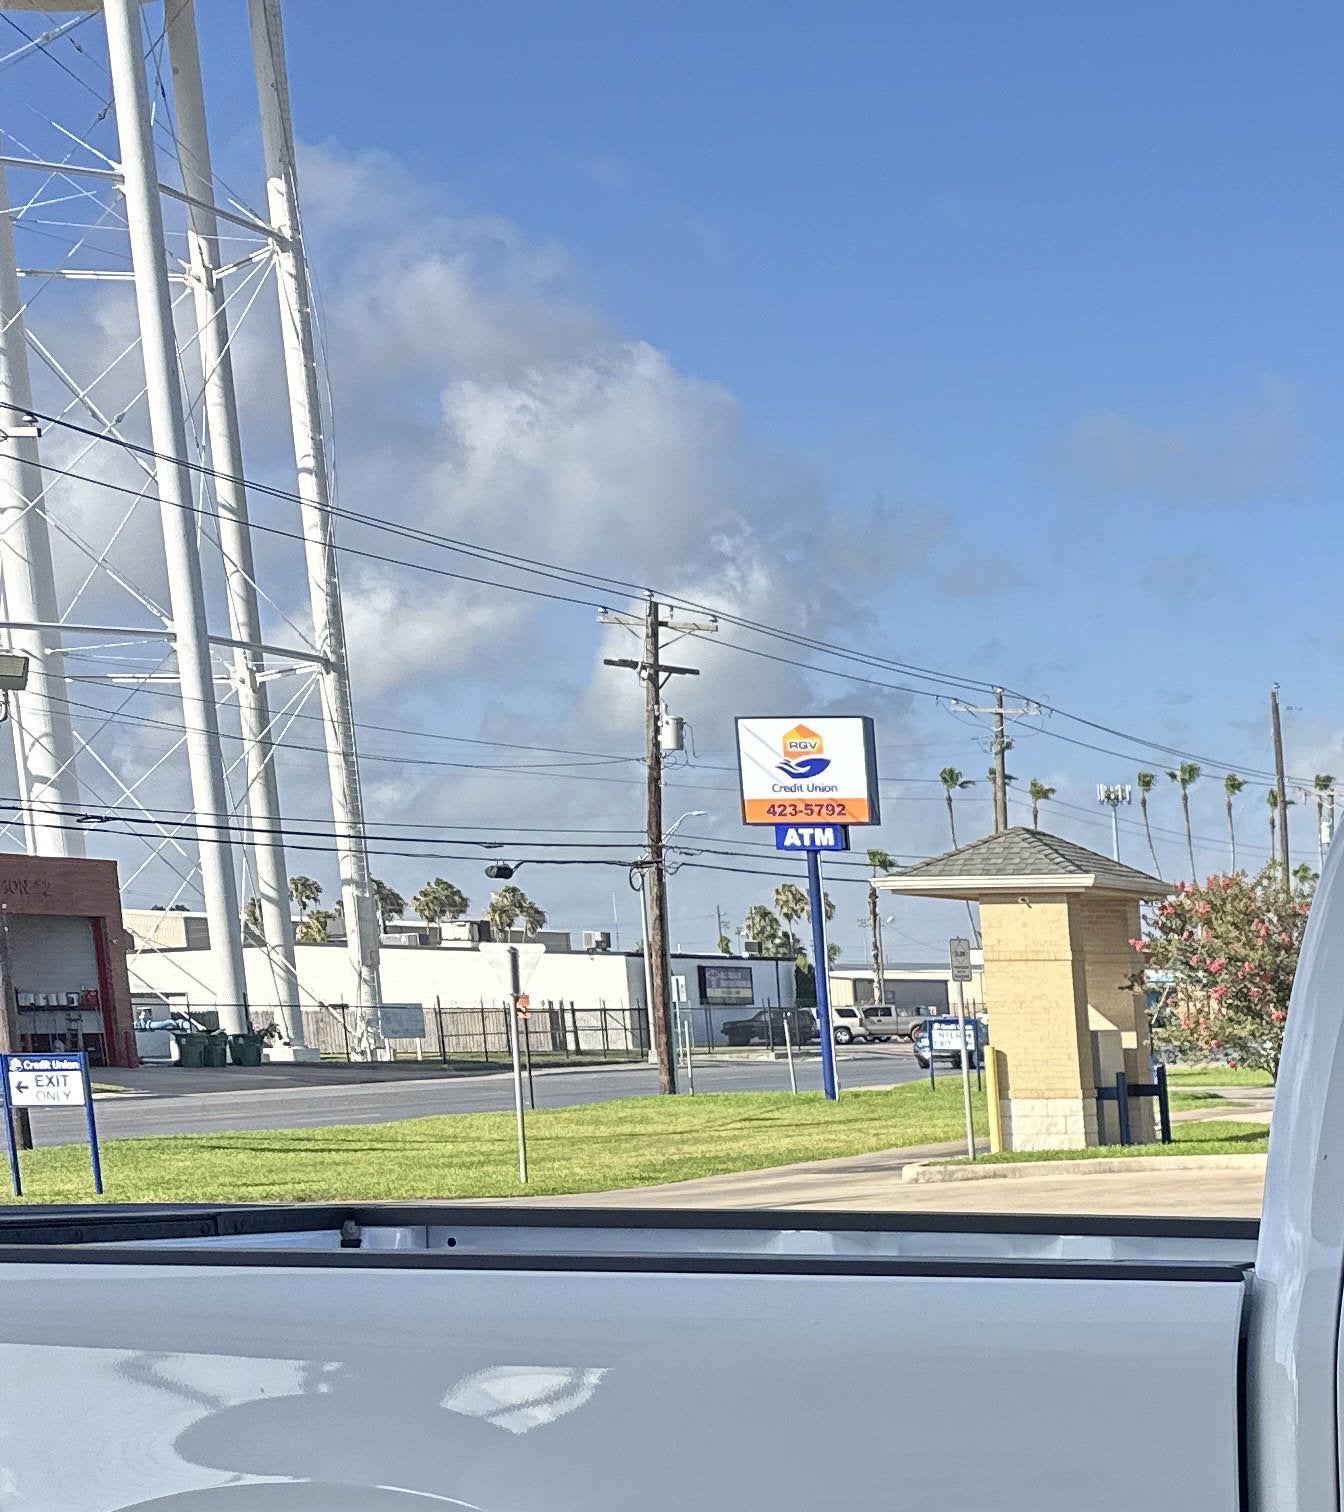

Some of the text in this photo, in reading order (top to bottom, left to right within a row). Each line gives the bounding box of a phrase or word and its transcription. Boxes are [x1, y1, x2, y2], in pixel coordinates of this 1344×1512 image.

[772, 783, 838, 793] Credit Union
[766, 802, 847, 817] 423-5792
[783, 827, 835, 847] ATM
[23, 1059, 80, 1070] Credit Union
[34, 1074, 69, 1088] EXIT
[35, 1090, 72, 1102] ONLY
